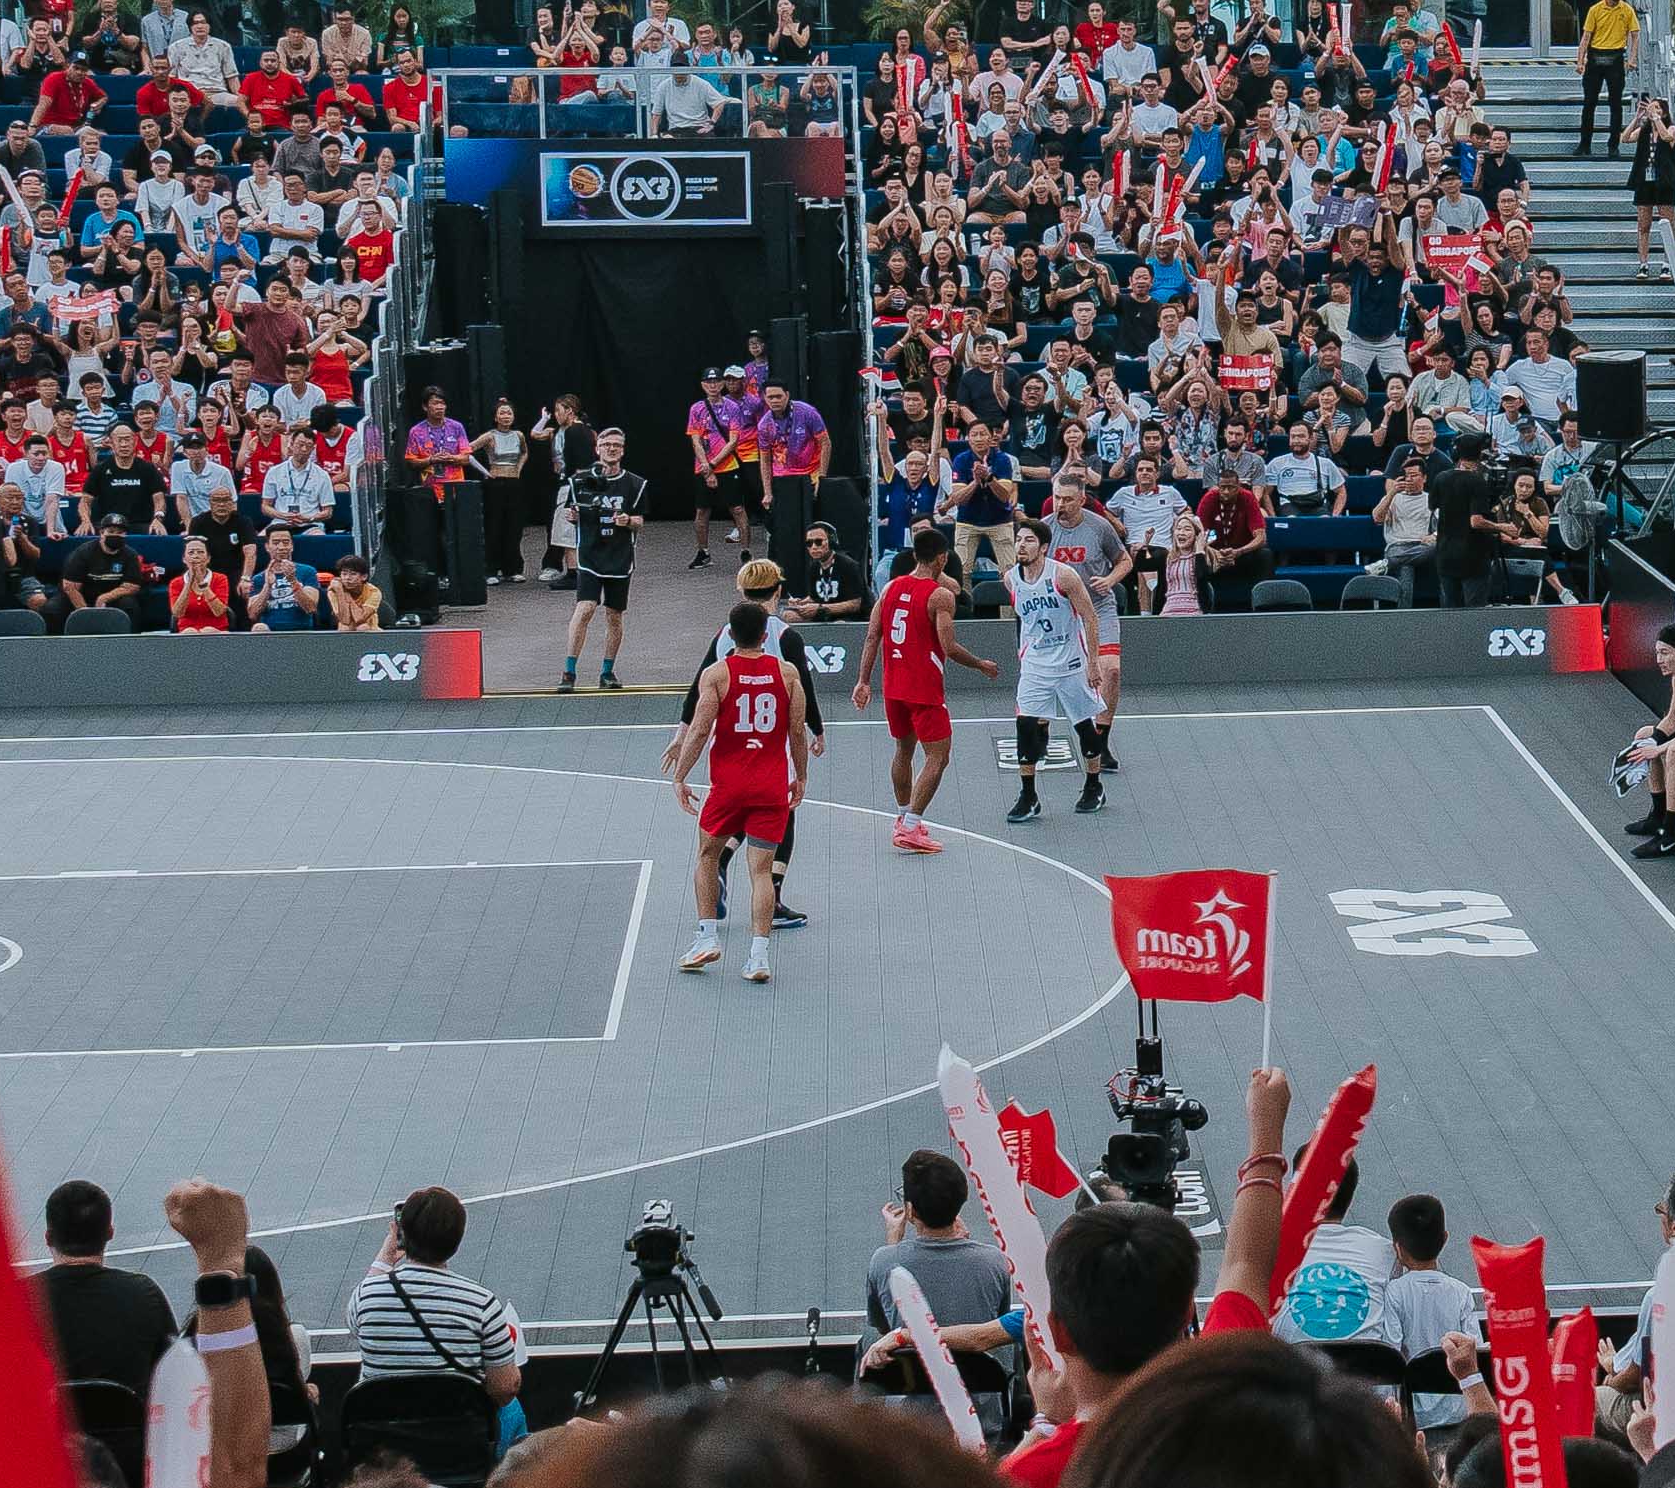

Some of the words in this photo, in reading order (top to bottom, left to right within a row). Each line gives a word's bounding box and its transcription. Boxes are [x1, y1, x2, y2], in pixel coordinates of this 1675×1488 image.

[110, 478, 141, 487] JAPAN
[1021, 596, 1060, 616] JAPAN
[891, 609, 909, 645] 5
[1037, 618, 1053, 633] 13
[735, 693, 777, 733] 18
